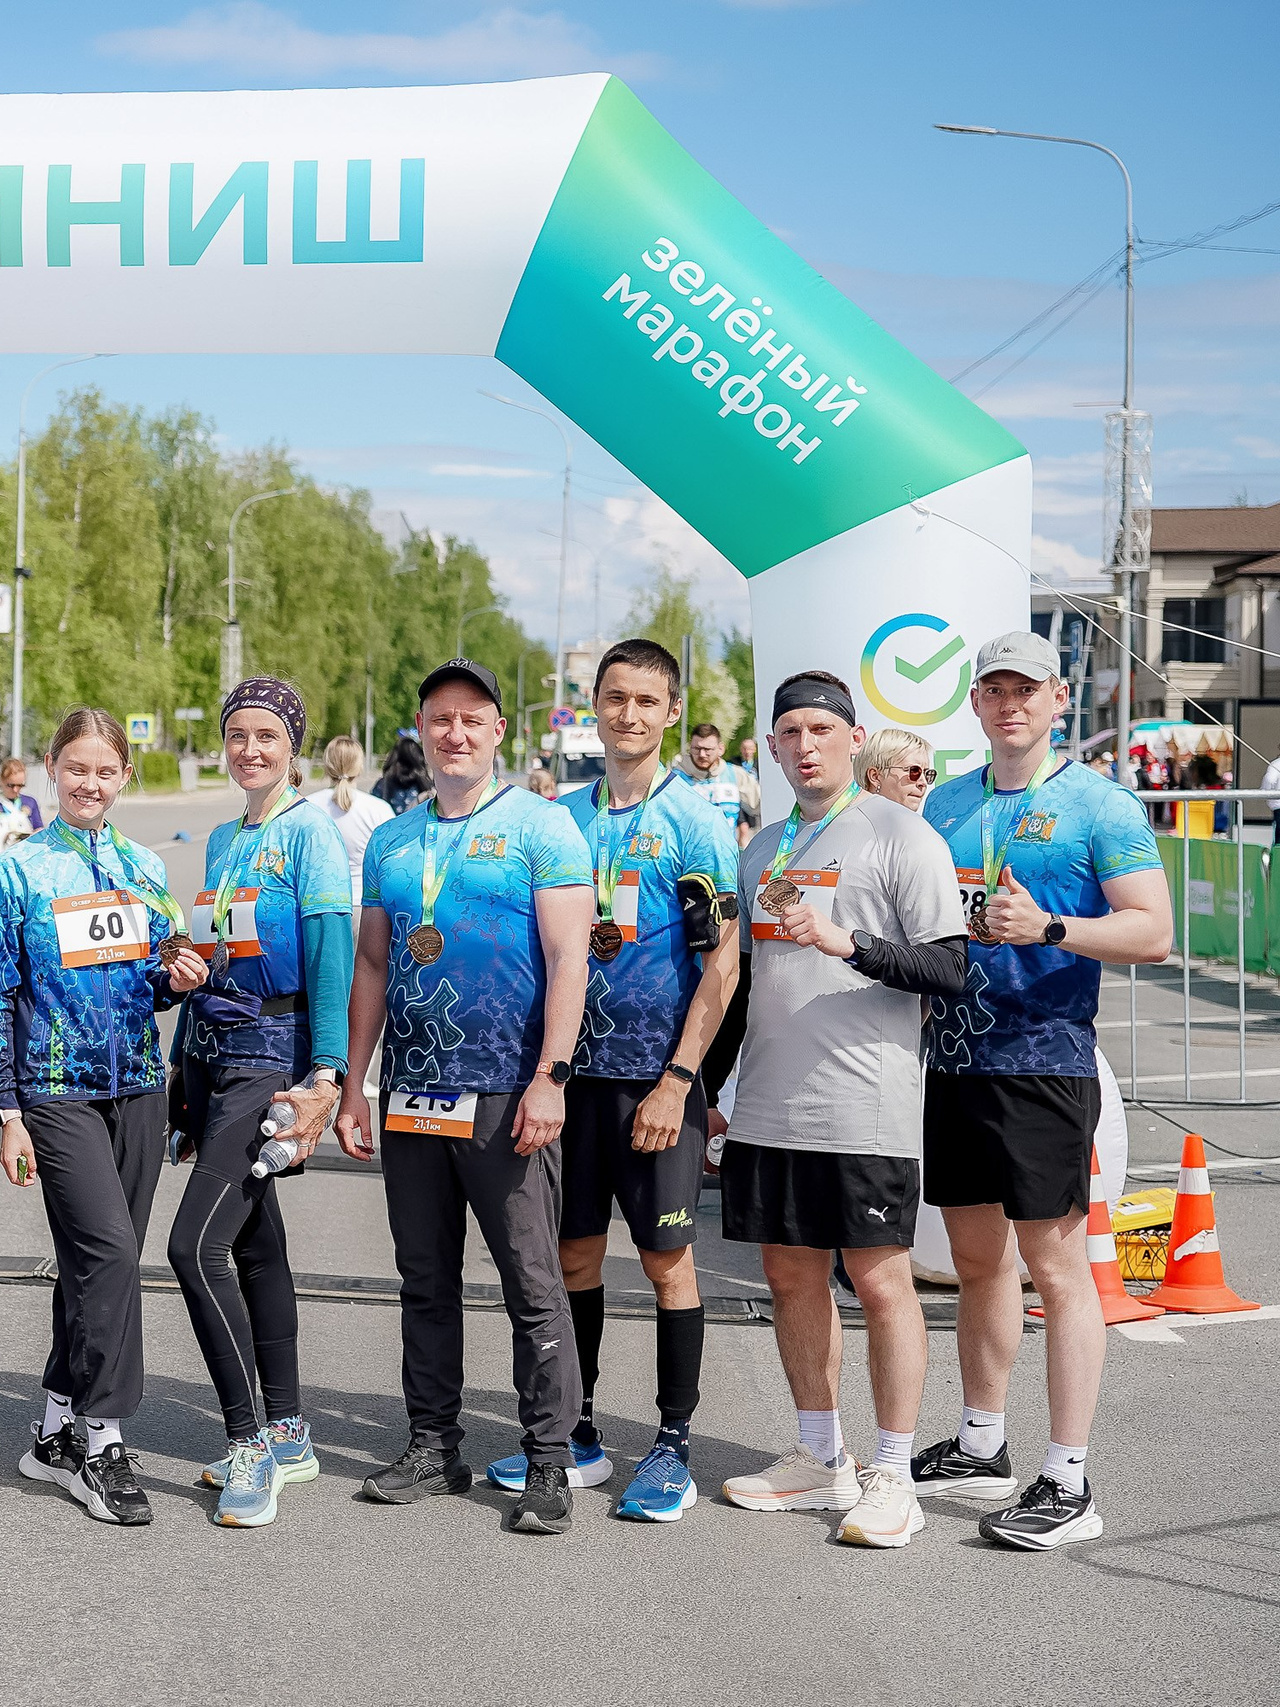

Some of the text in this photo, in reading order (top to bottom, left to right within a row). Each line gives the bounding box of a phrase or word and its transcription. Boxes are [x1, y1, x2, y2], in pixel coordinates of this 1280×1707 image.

[602, 273, 823, 465] марафон
[641, 236, 869, 427] зелёный
[88, 912, 124, 941] 60
[656, 1207, 687, 1227] FILA
